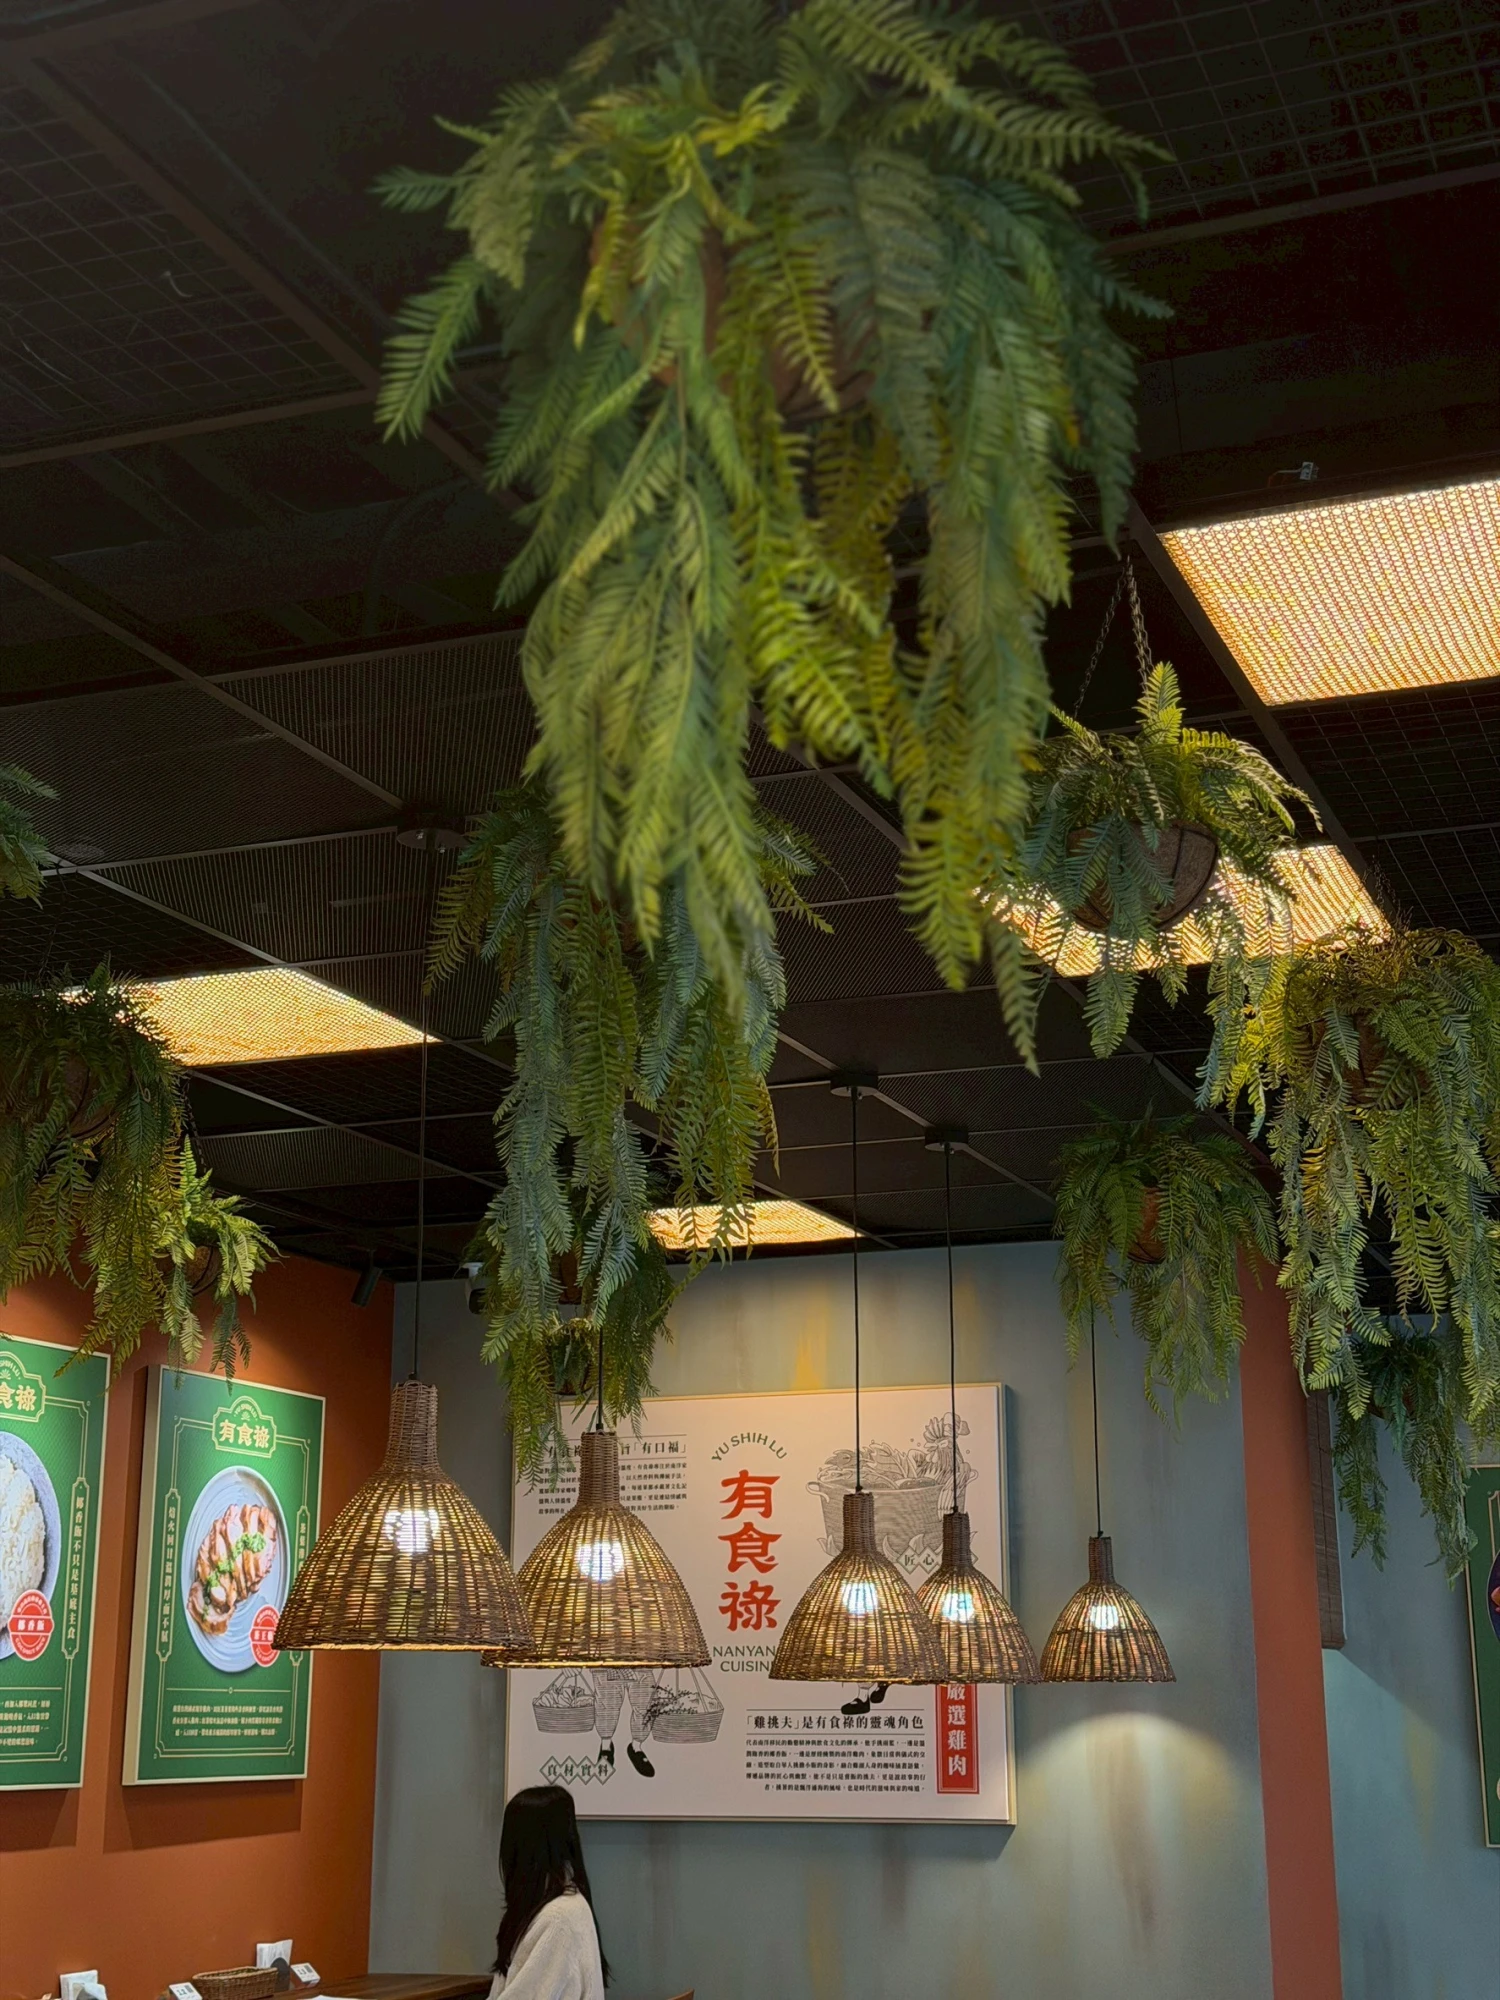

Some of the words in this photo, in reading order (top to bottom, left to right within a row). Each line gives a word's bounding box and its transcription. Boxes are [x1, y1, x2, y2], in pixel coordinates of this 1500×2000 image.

[219, 1419, 270, 1448] 有食祿
[711, 1442, 730, 1461] YU
[730, 1432, 768, 1447] SHIH
[768, 1439, 788, 1459] LU
[718, 1469, 783, 1632] 有食祿
[713, 1645, 776, 1657] NANYAN
[720, 1660, 772, 1672] CUISIN
[746, 1715, 925, 1730] 「雞挑夫」是有食祿的靈魂角色
[947, 1683, 967, 1776] 嚴選雞肉
